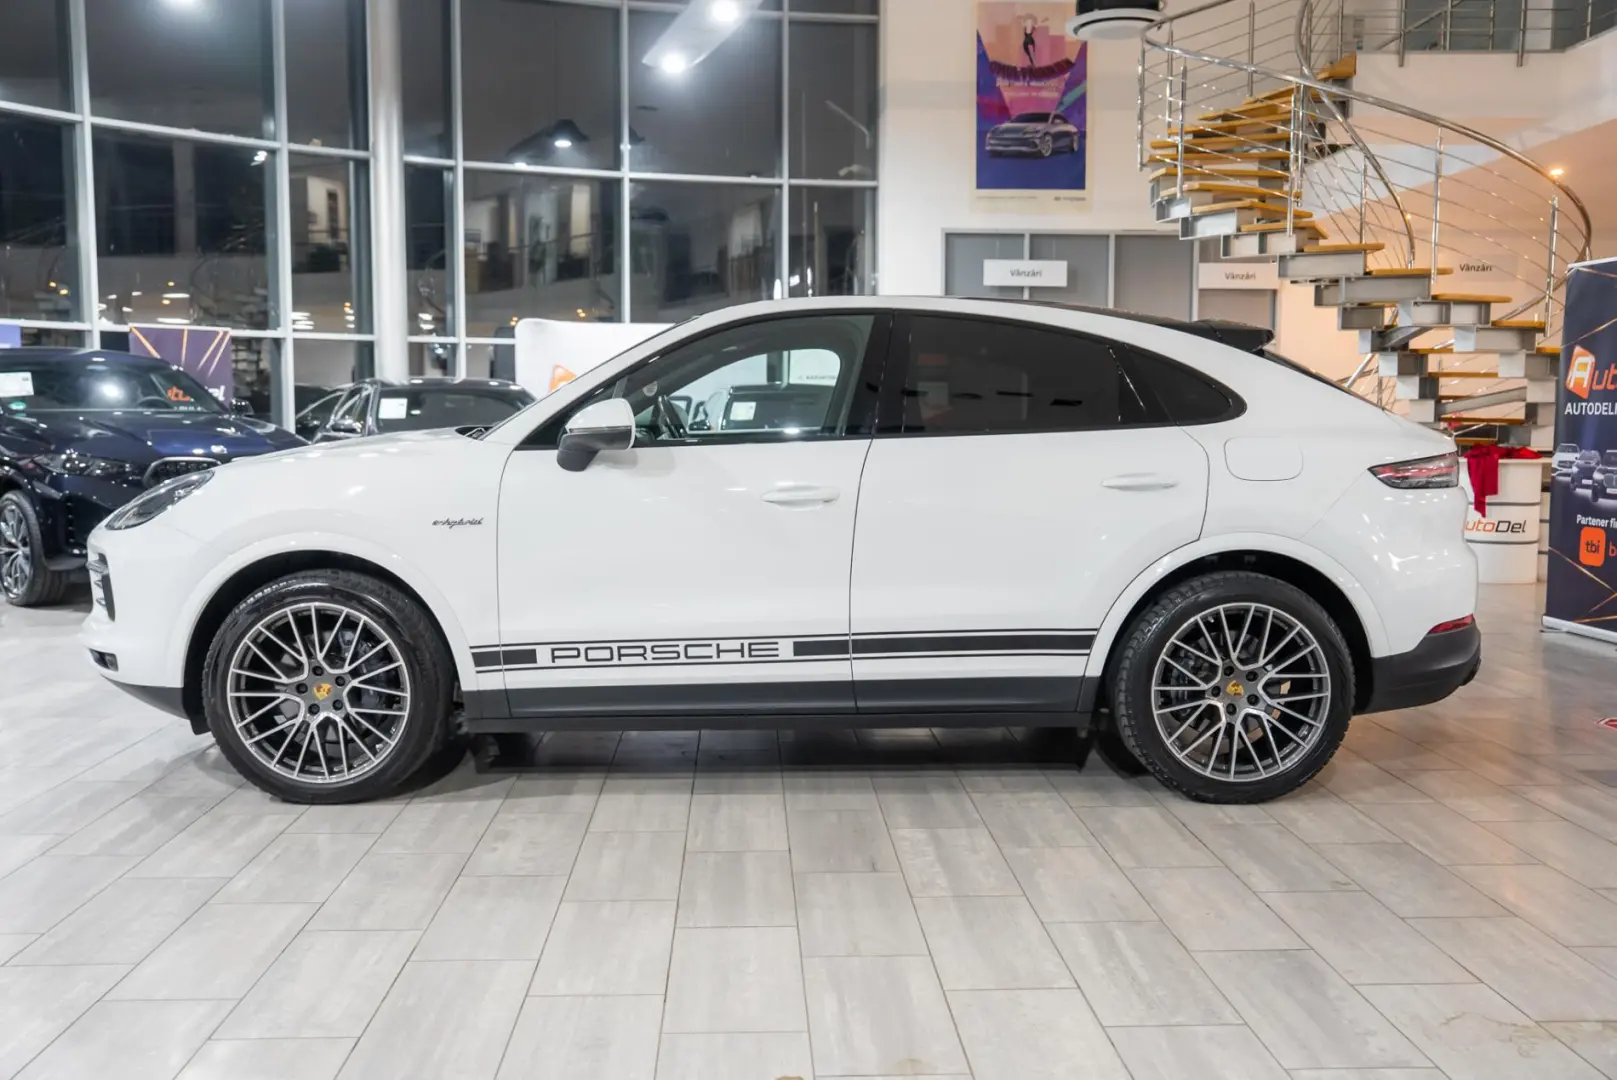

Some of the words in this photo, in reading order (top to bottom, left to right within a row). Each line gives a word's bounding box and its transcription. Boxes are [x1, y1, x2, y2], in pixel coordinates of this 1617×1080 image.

[1465, 519, 1527, 533] utoDel
[1576, 514, 1609, 527] Partener
[1586, 540, 1600, 554] tbi
[551, 641, 779, 663] PORSCHE
